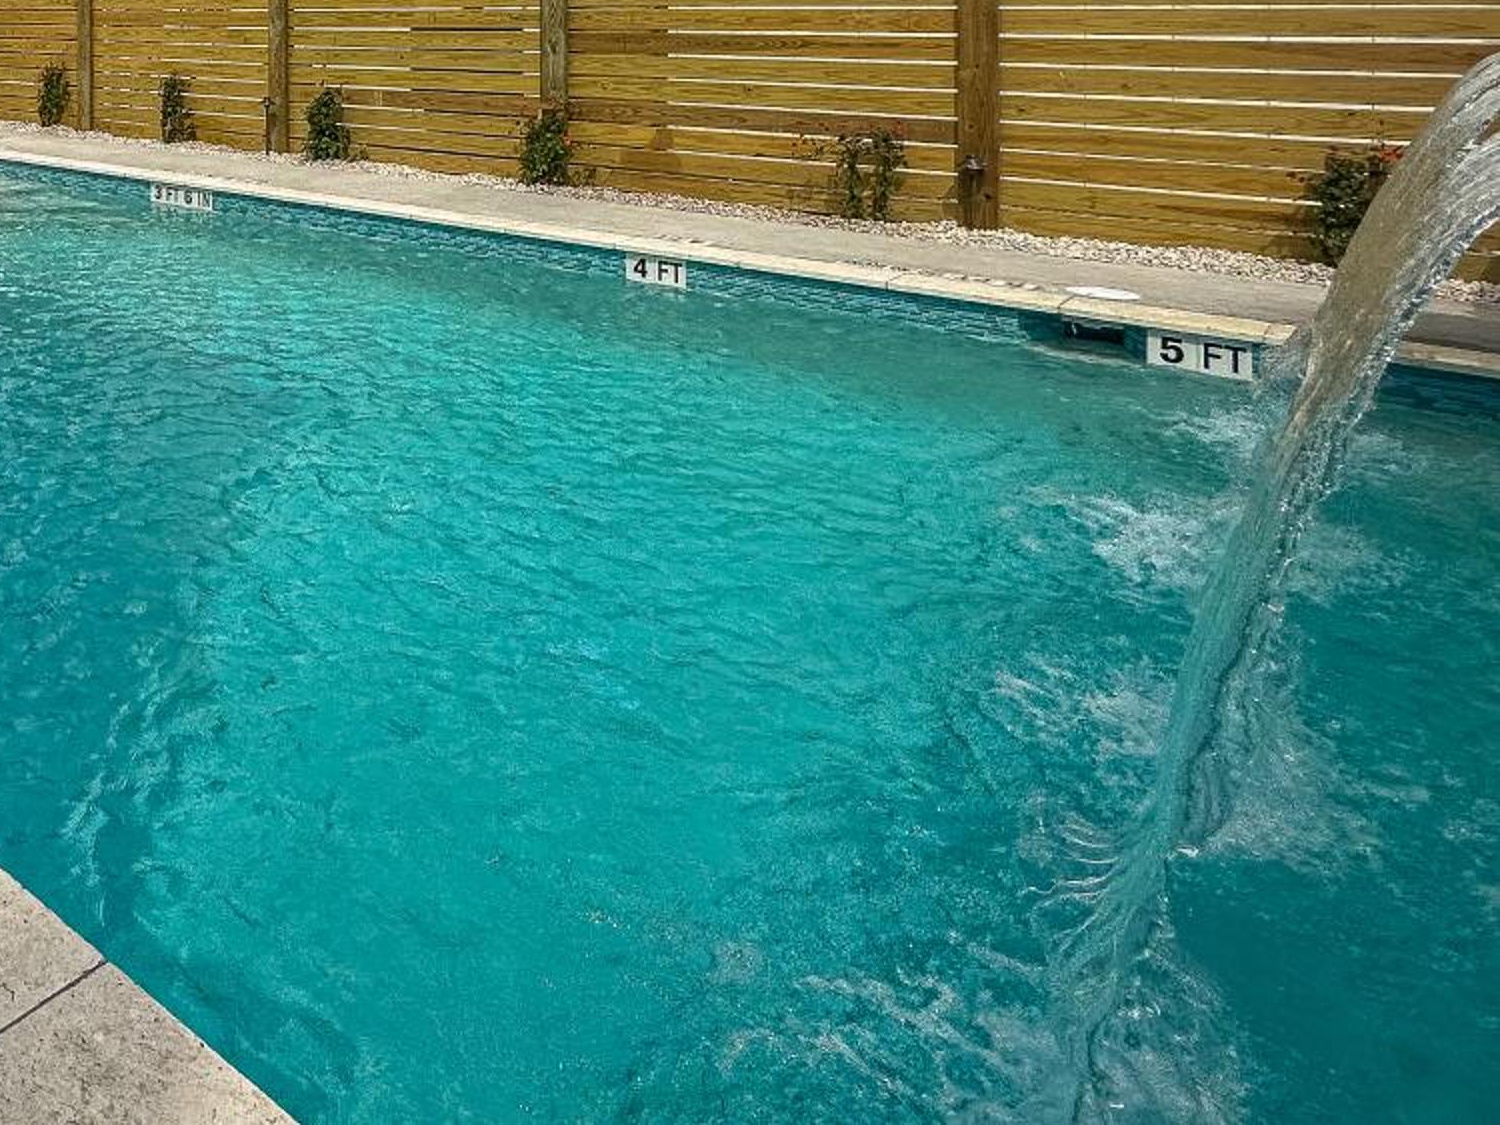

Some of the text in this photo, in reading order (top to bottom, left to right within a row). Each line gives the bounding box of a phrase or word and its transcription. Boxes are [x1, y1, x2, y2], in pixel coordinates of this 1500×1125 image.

[154, 184, 211, 207] 3 FT 6 IN
[633, 258, 683, 284] 4 FT
[1159, 336, 1248, 374] 5 FT
